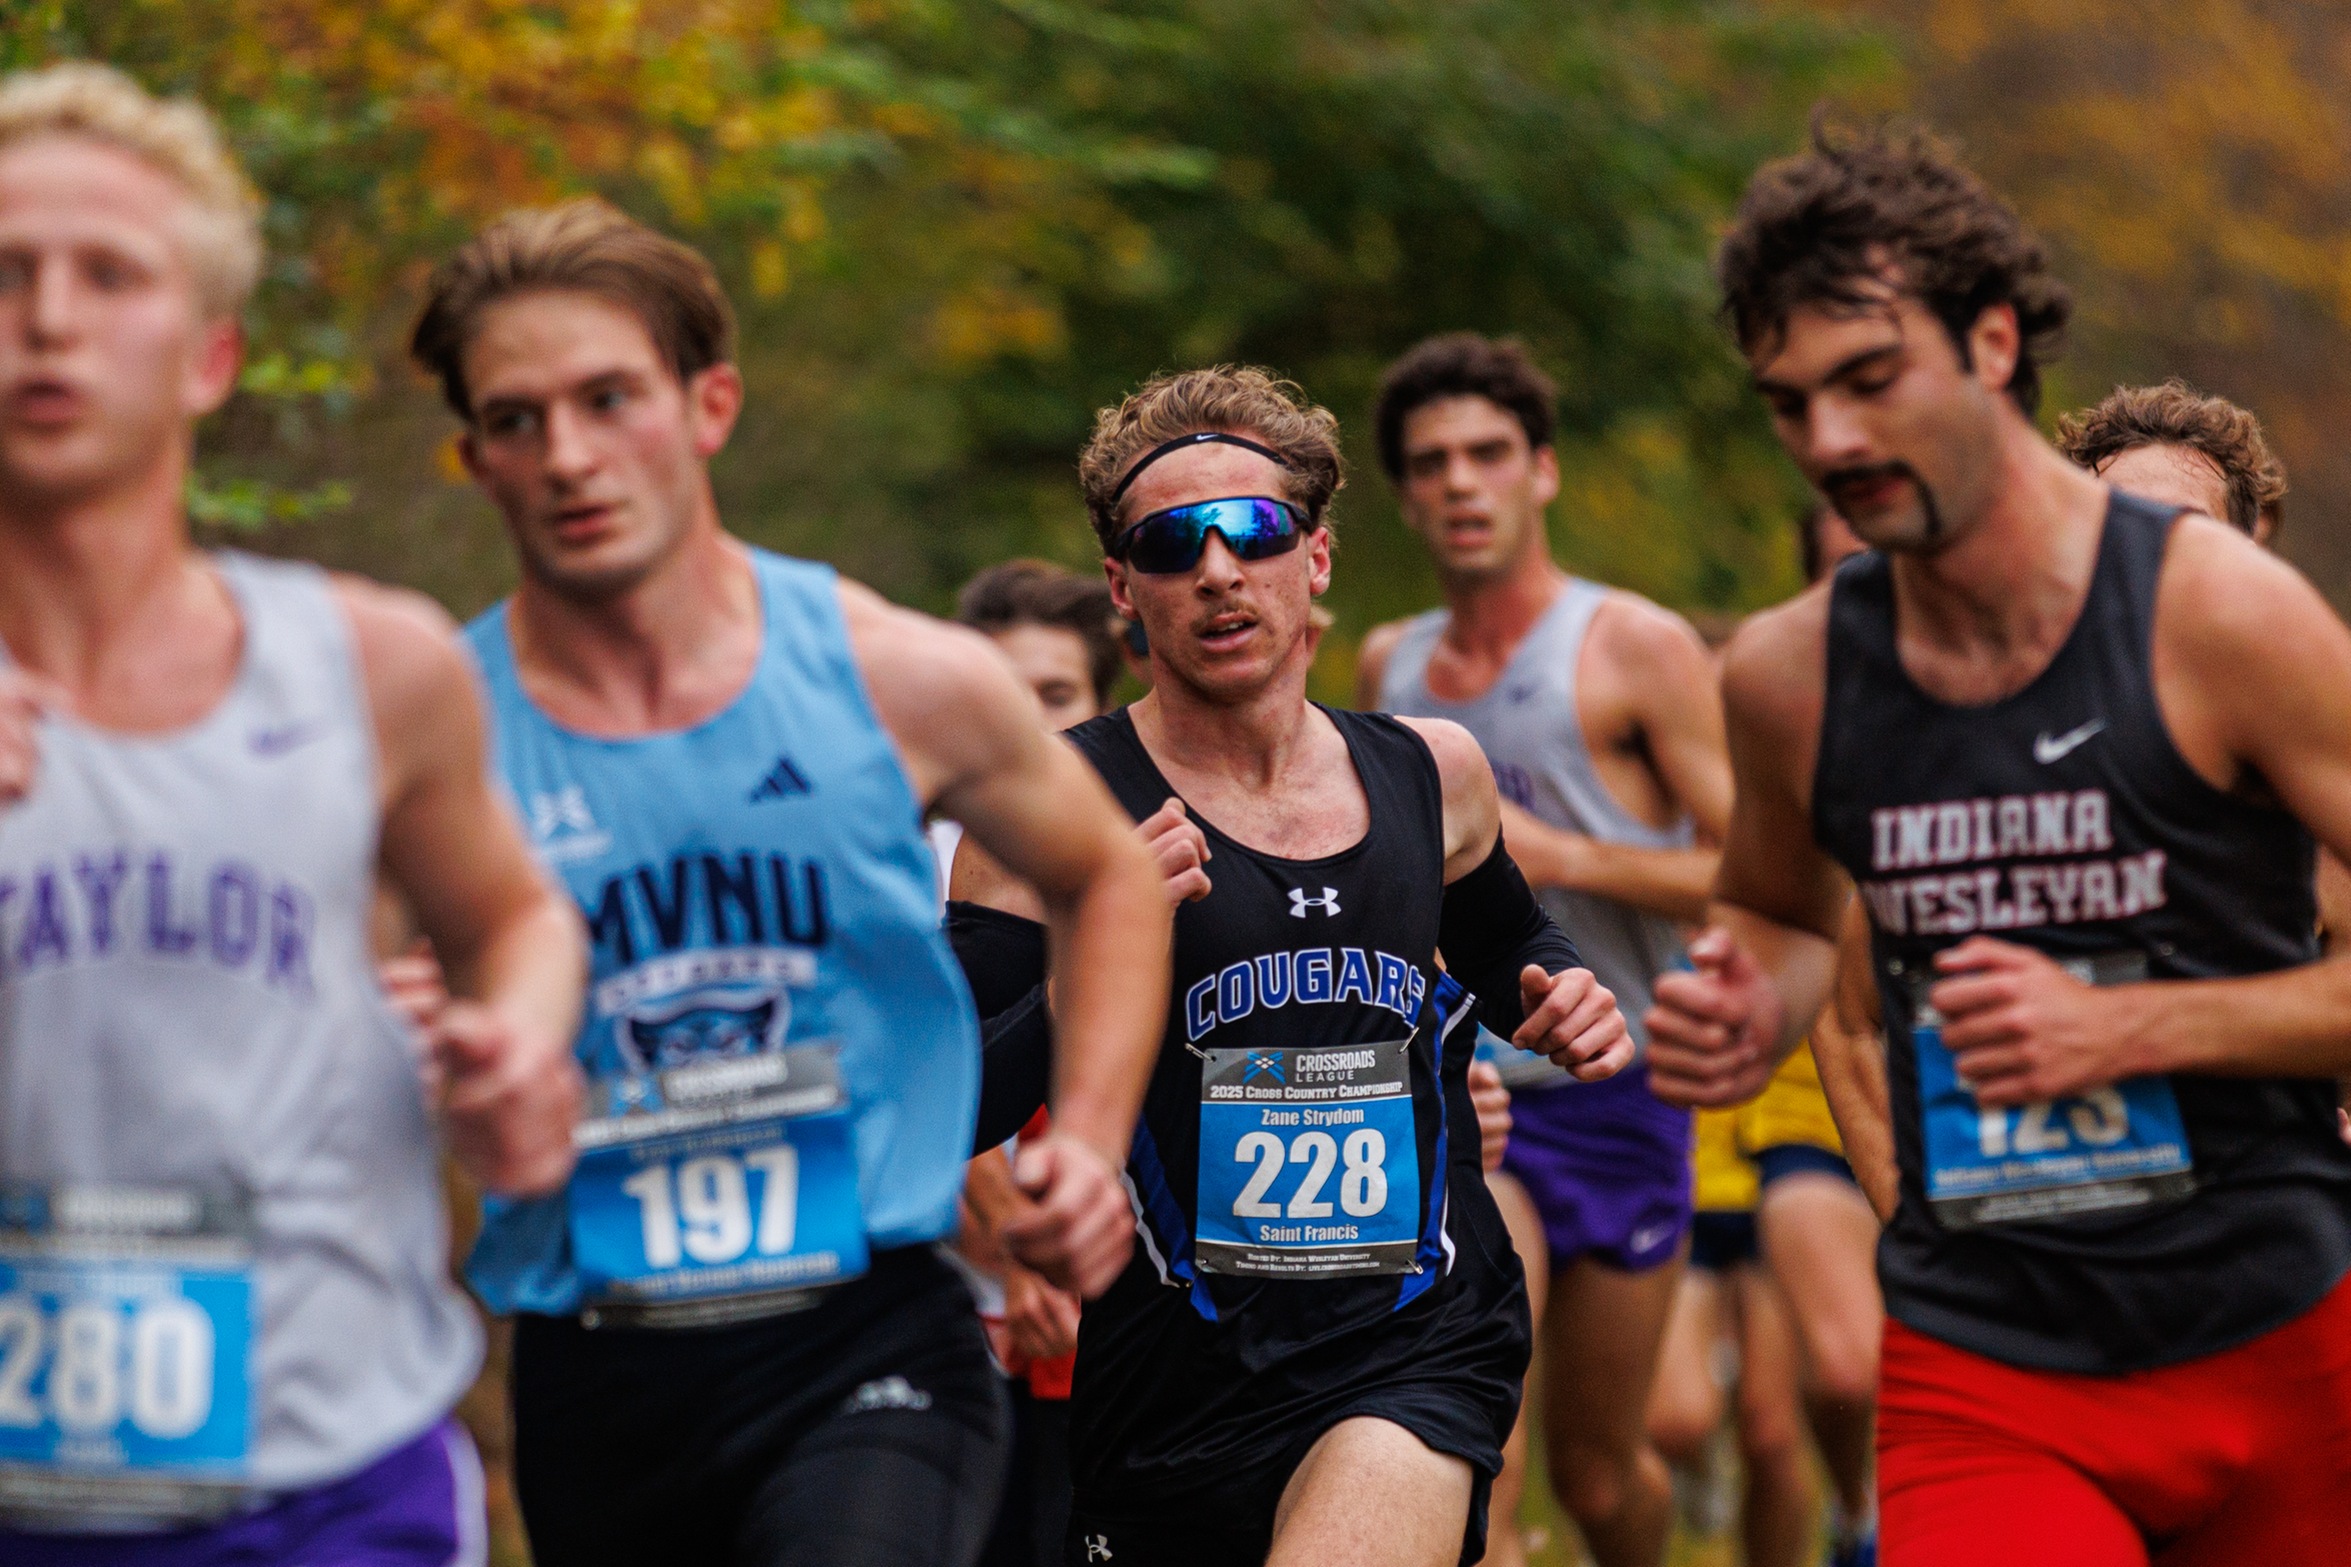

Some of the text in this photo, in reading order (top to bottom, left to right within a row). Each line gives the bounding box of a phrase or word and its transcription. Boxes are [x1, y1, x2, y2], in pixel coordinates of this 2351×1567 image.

[1872, 789, 2113, 872] INDIANA
[1859, 850, 2168, 936] WESLEYAN
[1186, 947, 1426, 1042] COUGARS
[1210, 1085, 1244, 1099] 2025
[1295, 1070, 1355, 1083] LEAGUE
[1296, 1050, 1376, 1072] CROSSROADS
[1261, 1108, 1365, 1127] Zane Strydom
[622, 1143, 800, 1271] 197
[1232, 1128, 1388, 1219] 228
[1260, 1223, 1359, 1242] Saint Francis
[0, 1300, 213, 1440] 280
